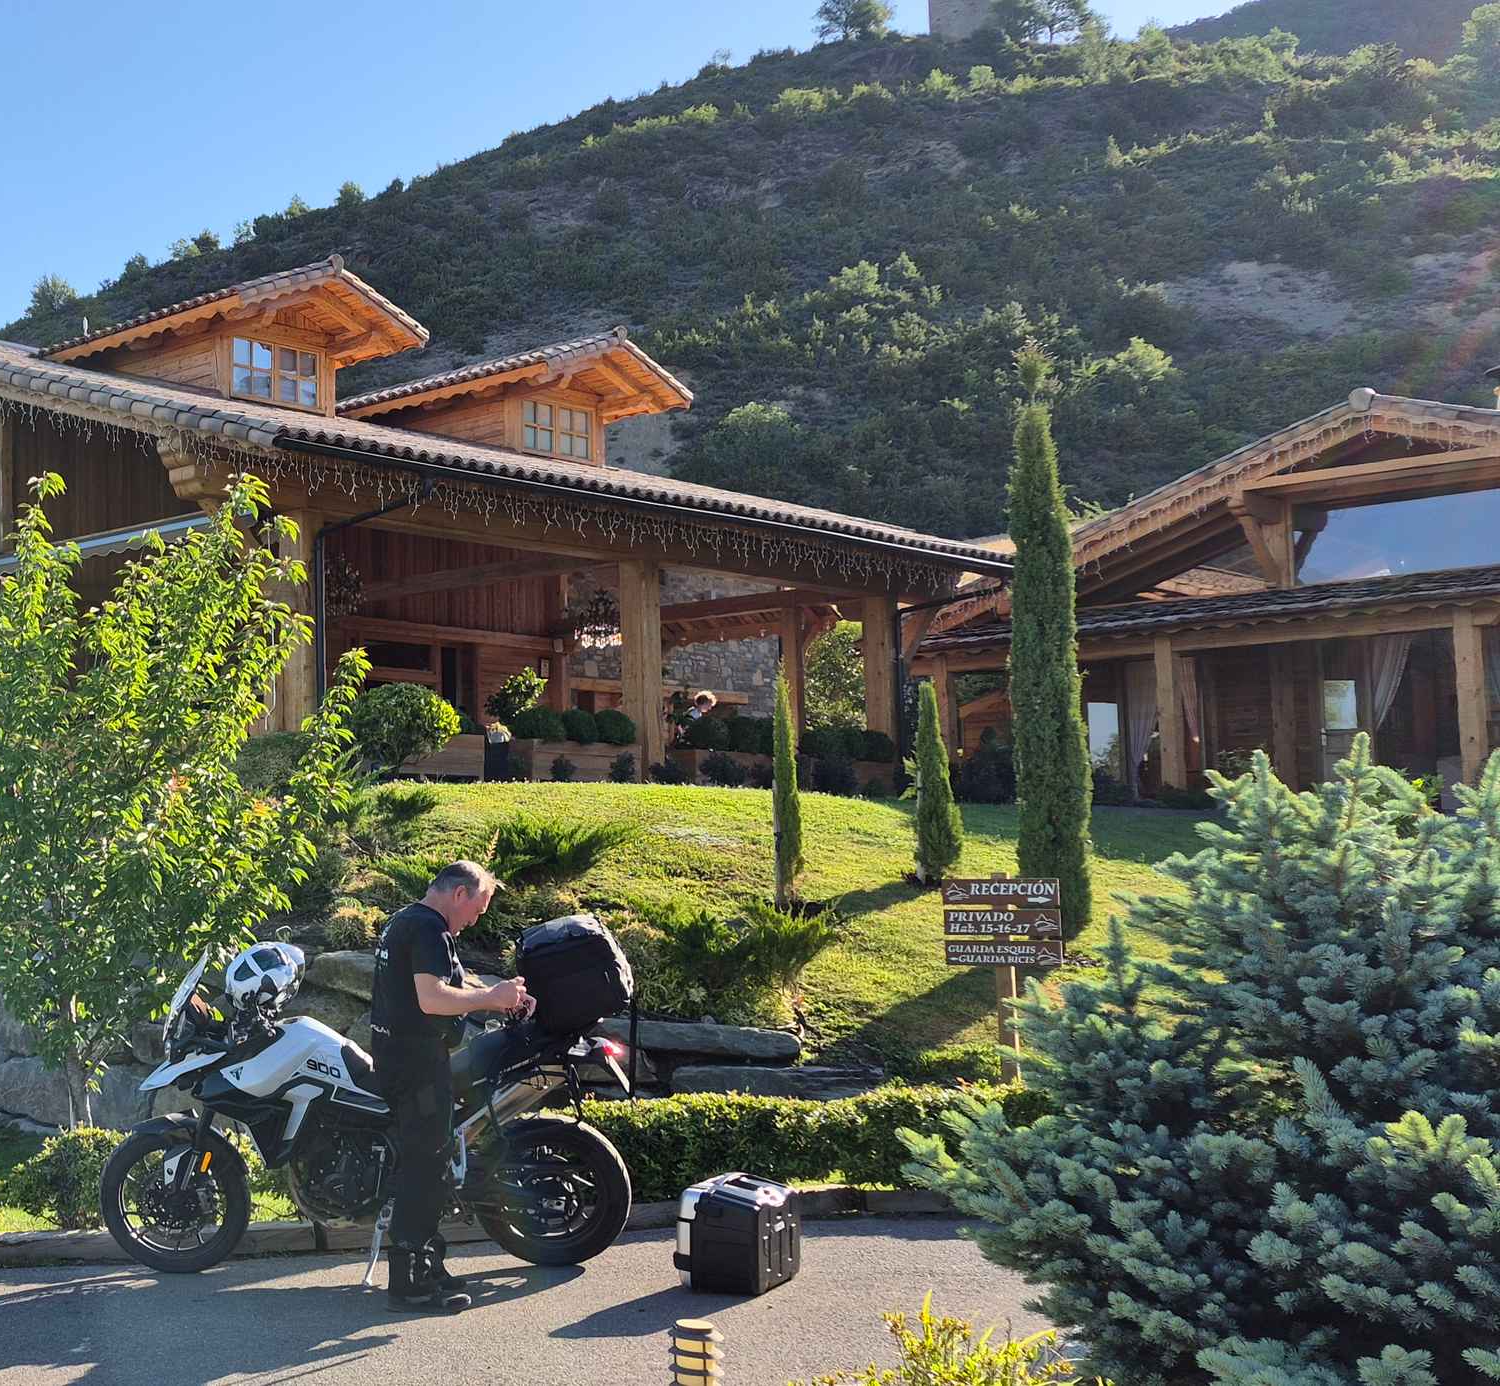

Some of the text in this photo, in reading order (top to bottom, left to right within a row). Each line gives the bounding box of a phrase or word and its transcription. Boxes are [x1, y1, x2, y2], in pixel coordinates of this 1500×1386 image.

[970, 880, 1055, 895] RECEPCIÓN
[948, 911, 1015, 922] PRIVADO
[949, 923, 1030, 934] Hab. 15-16-17
[948, 944, 1037, 955] GUARDA ESQUIS
[958, 954, 1005, 963] GUARDA
[306, 1058, 341, 1079] 900
